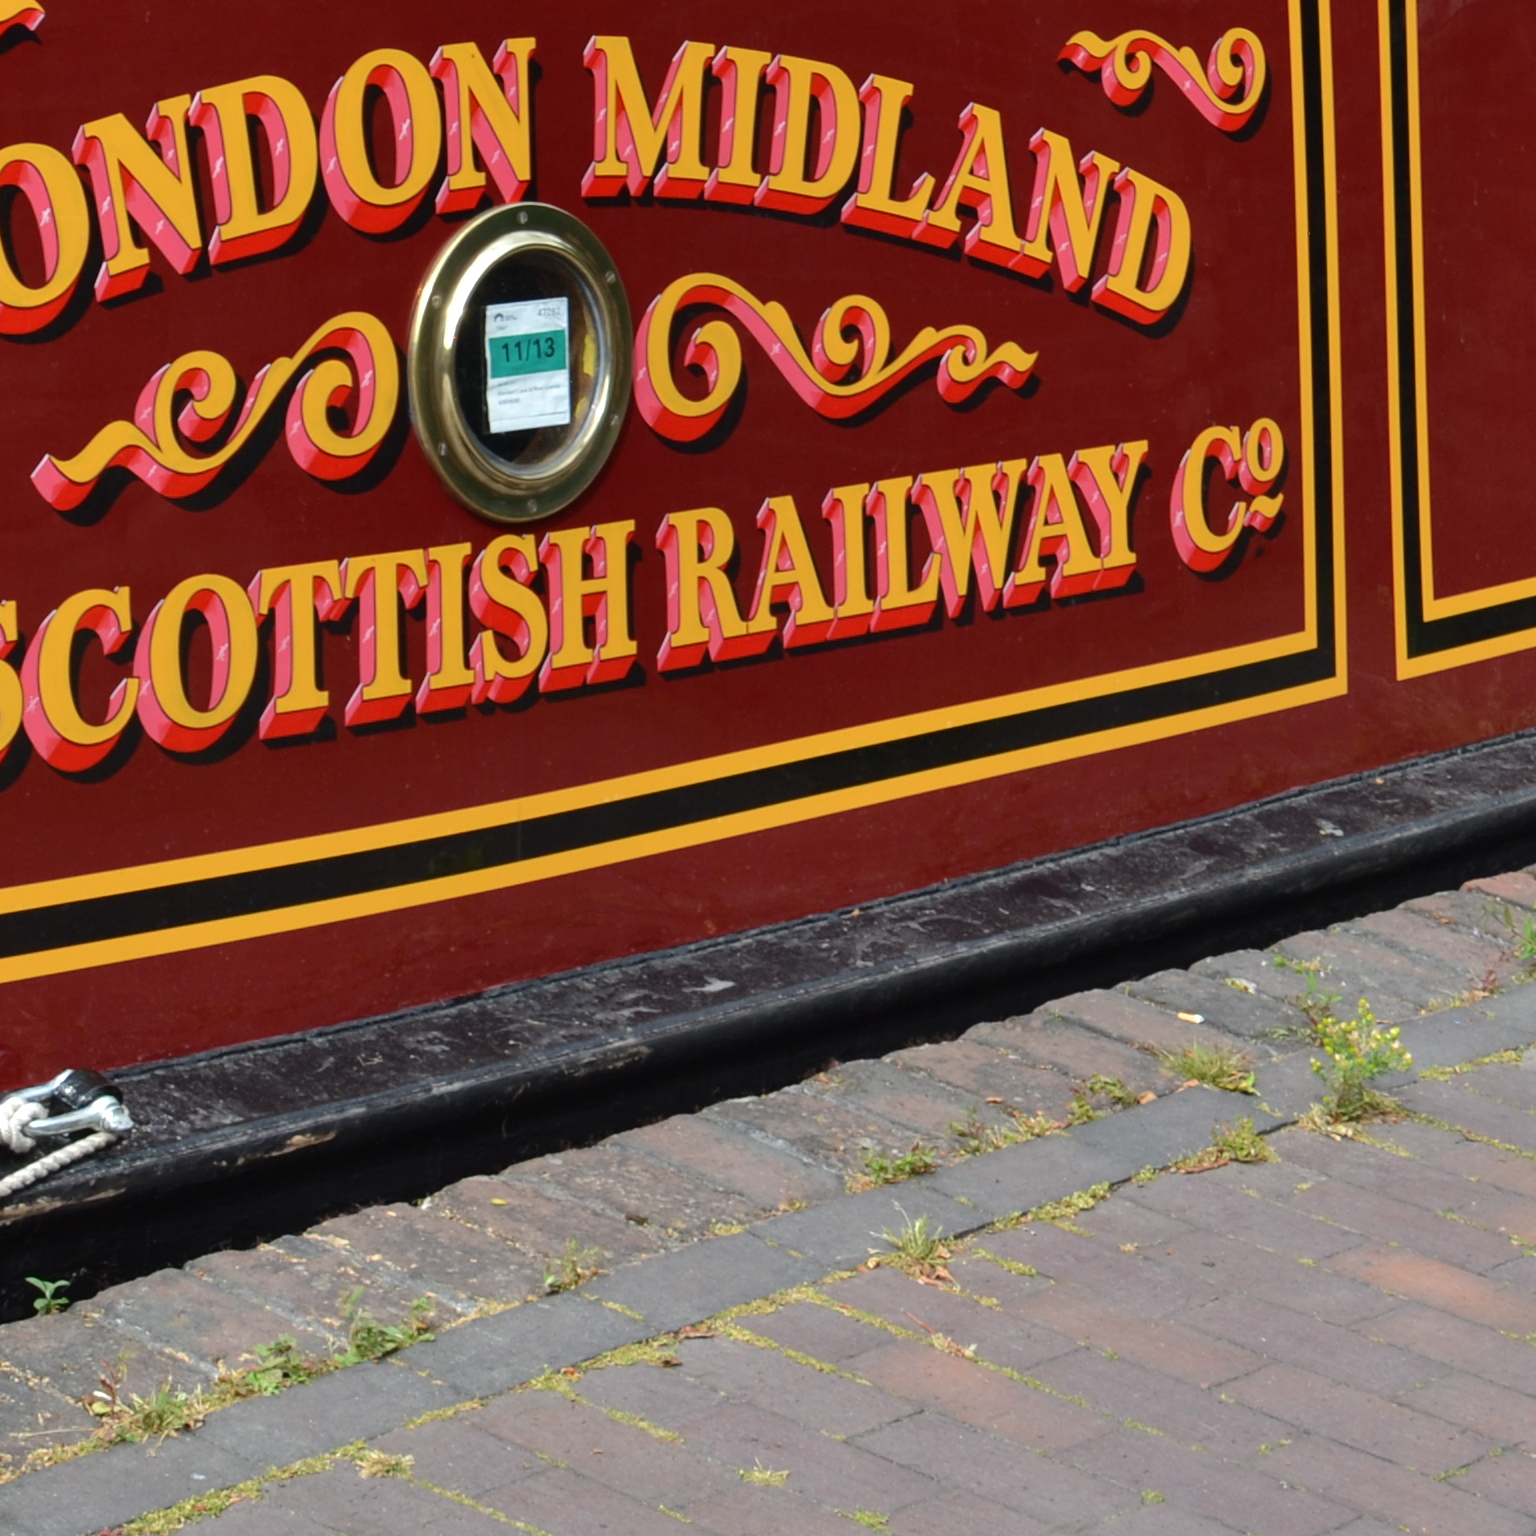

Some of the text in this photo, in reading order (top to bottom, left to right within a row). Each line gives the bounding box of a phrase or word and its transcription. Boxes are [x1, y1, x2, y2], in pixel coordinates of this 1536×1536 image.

[581, 35, 1192, 325] MIDLAND
[502, 337, 556, 363] 11/13
[656, 439, 1149, 672] RAILWAY
